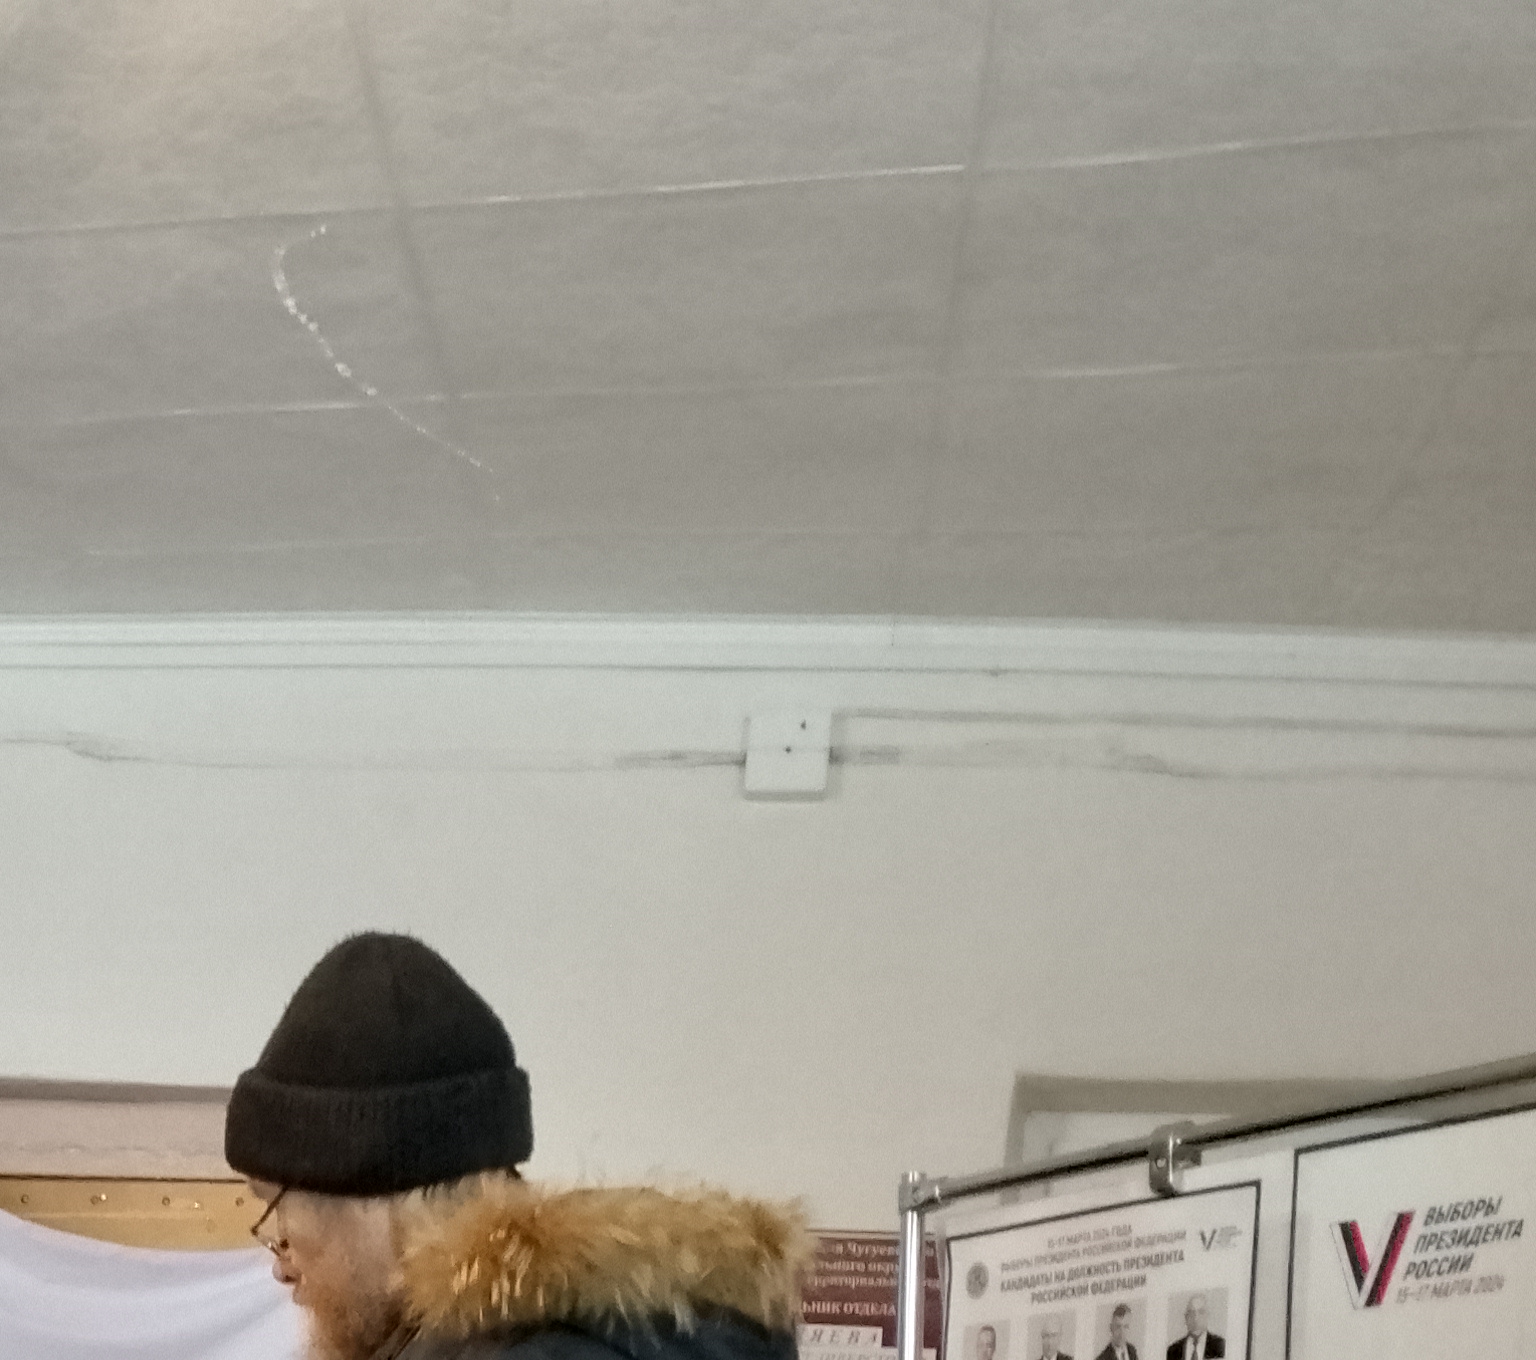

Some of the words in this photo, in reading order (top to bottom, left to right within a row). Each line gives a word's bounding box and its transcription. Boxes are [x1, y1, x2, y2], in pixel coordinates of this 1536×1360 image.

[1423, 1196, 1503, 1227] ВЫБОРЫ
[1414, 1219, 1525, 1253] ПРЕЗИДЕНТА
[1403, 1253, 1475, 1281] РОССИИ
